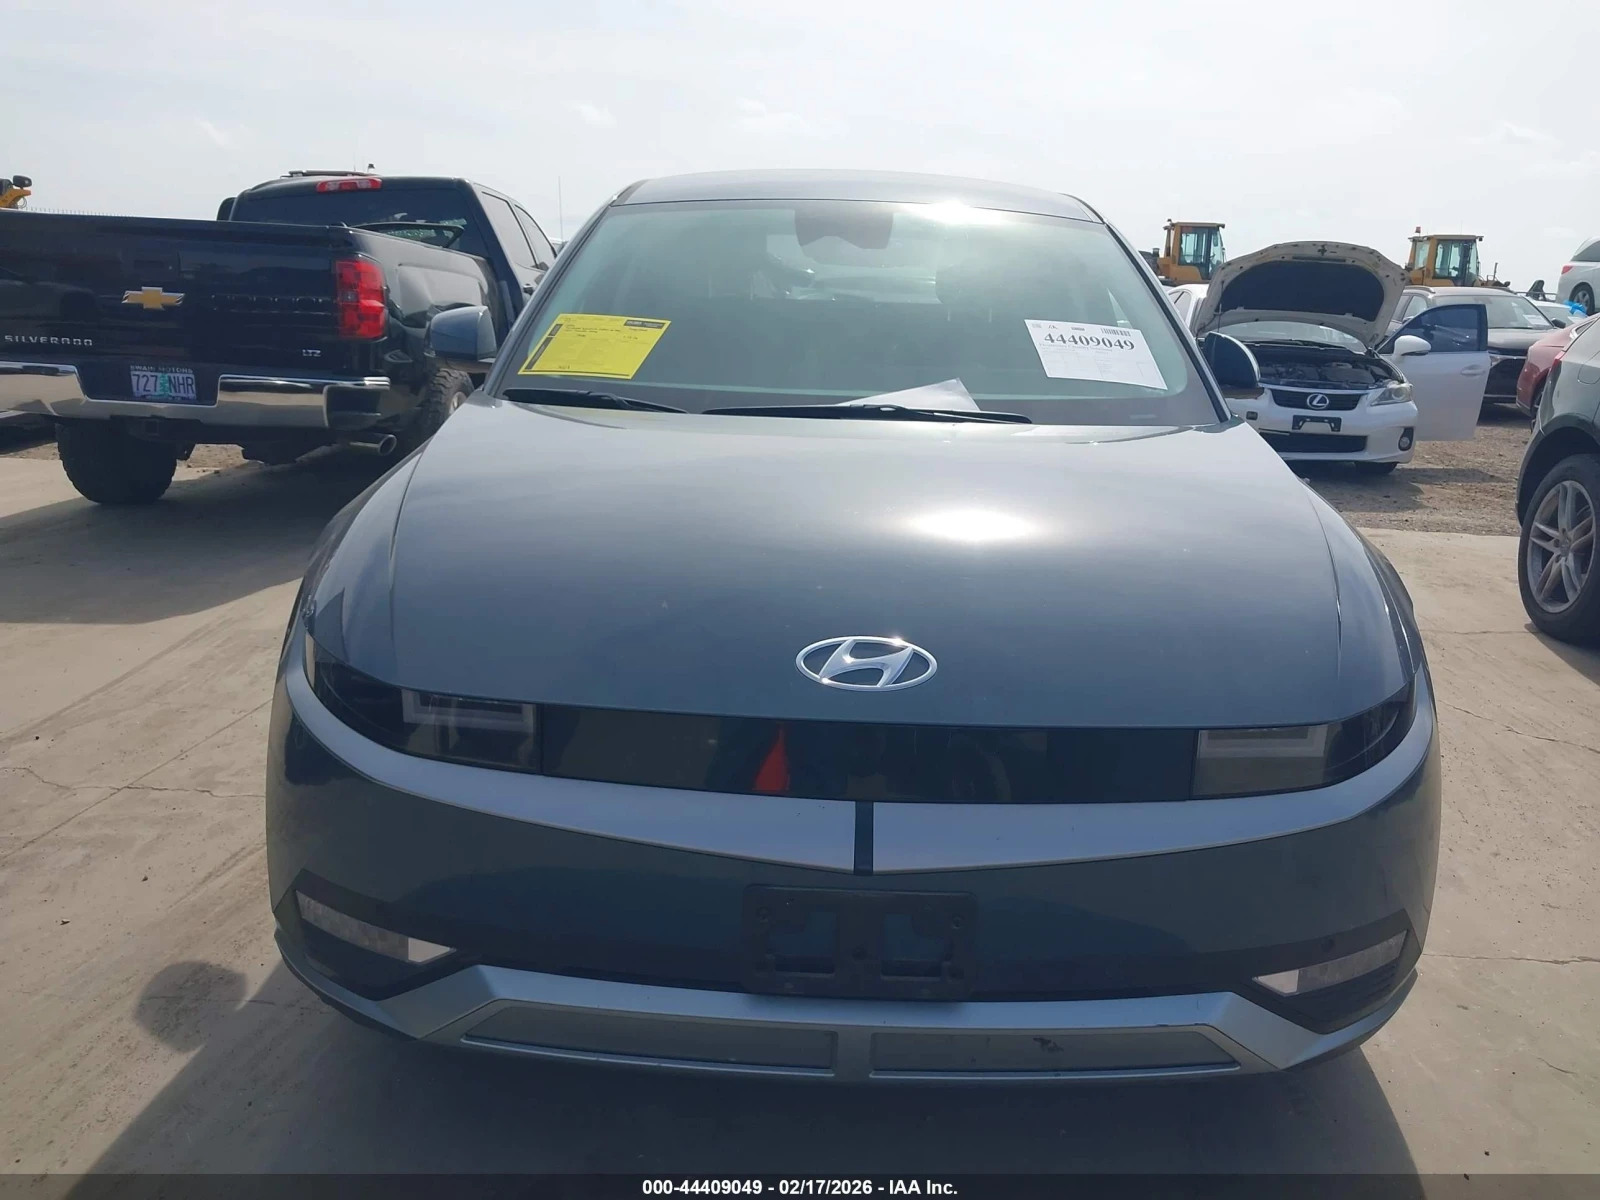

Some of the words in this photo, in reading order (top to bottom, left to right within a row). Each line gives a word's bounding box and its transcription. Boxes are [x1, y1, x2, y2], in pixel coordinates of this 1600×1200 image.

[4, 335, 93, 346] SILVERADO
[1044, 333, 1135, 351] 44409049
[302, 349, 321, 357] LTZ
[132, 374, 158, 392] 727
[168, 375, 195, 394] NHR
